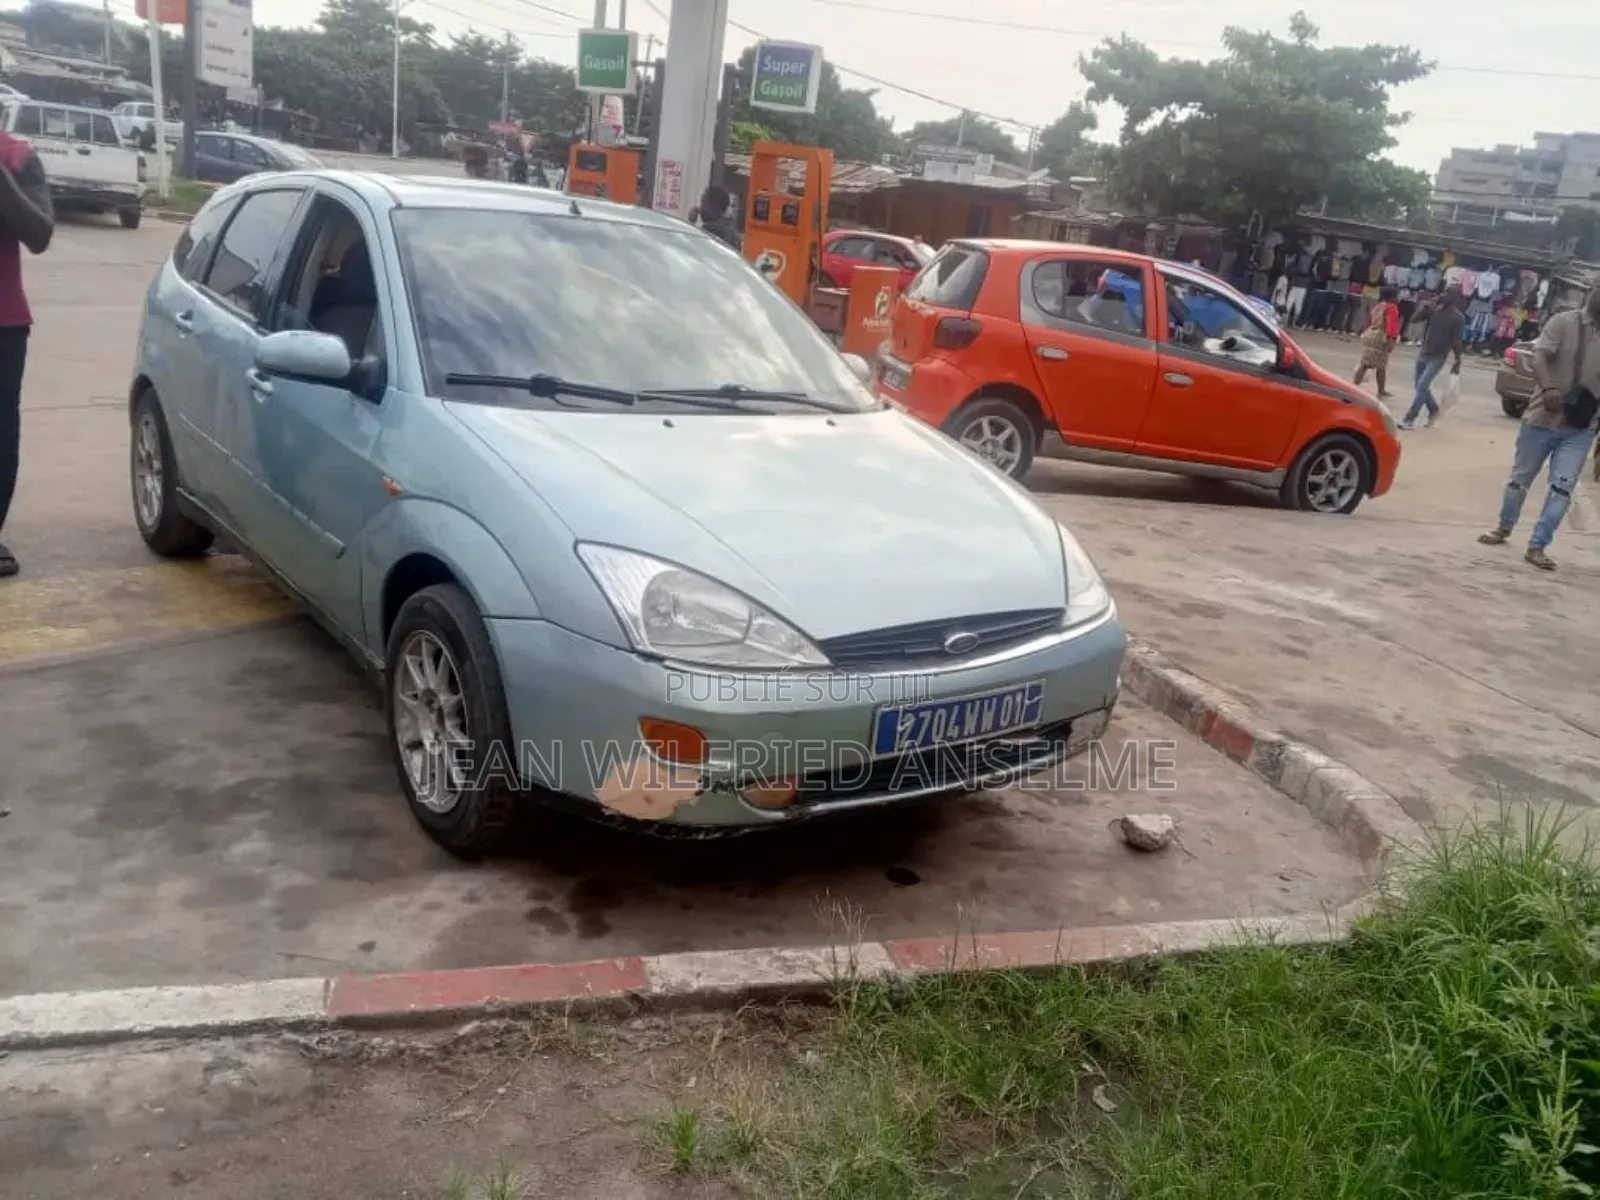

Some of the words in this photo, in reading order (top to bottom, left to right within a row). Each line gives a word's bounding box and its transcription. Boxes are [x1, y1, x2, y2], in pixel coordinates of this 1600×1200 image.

[583, 53, 625, 71] Gasoil
[763, 55, 807, 76] Super
[760, 80, 804, 98] Gasoil
